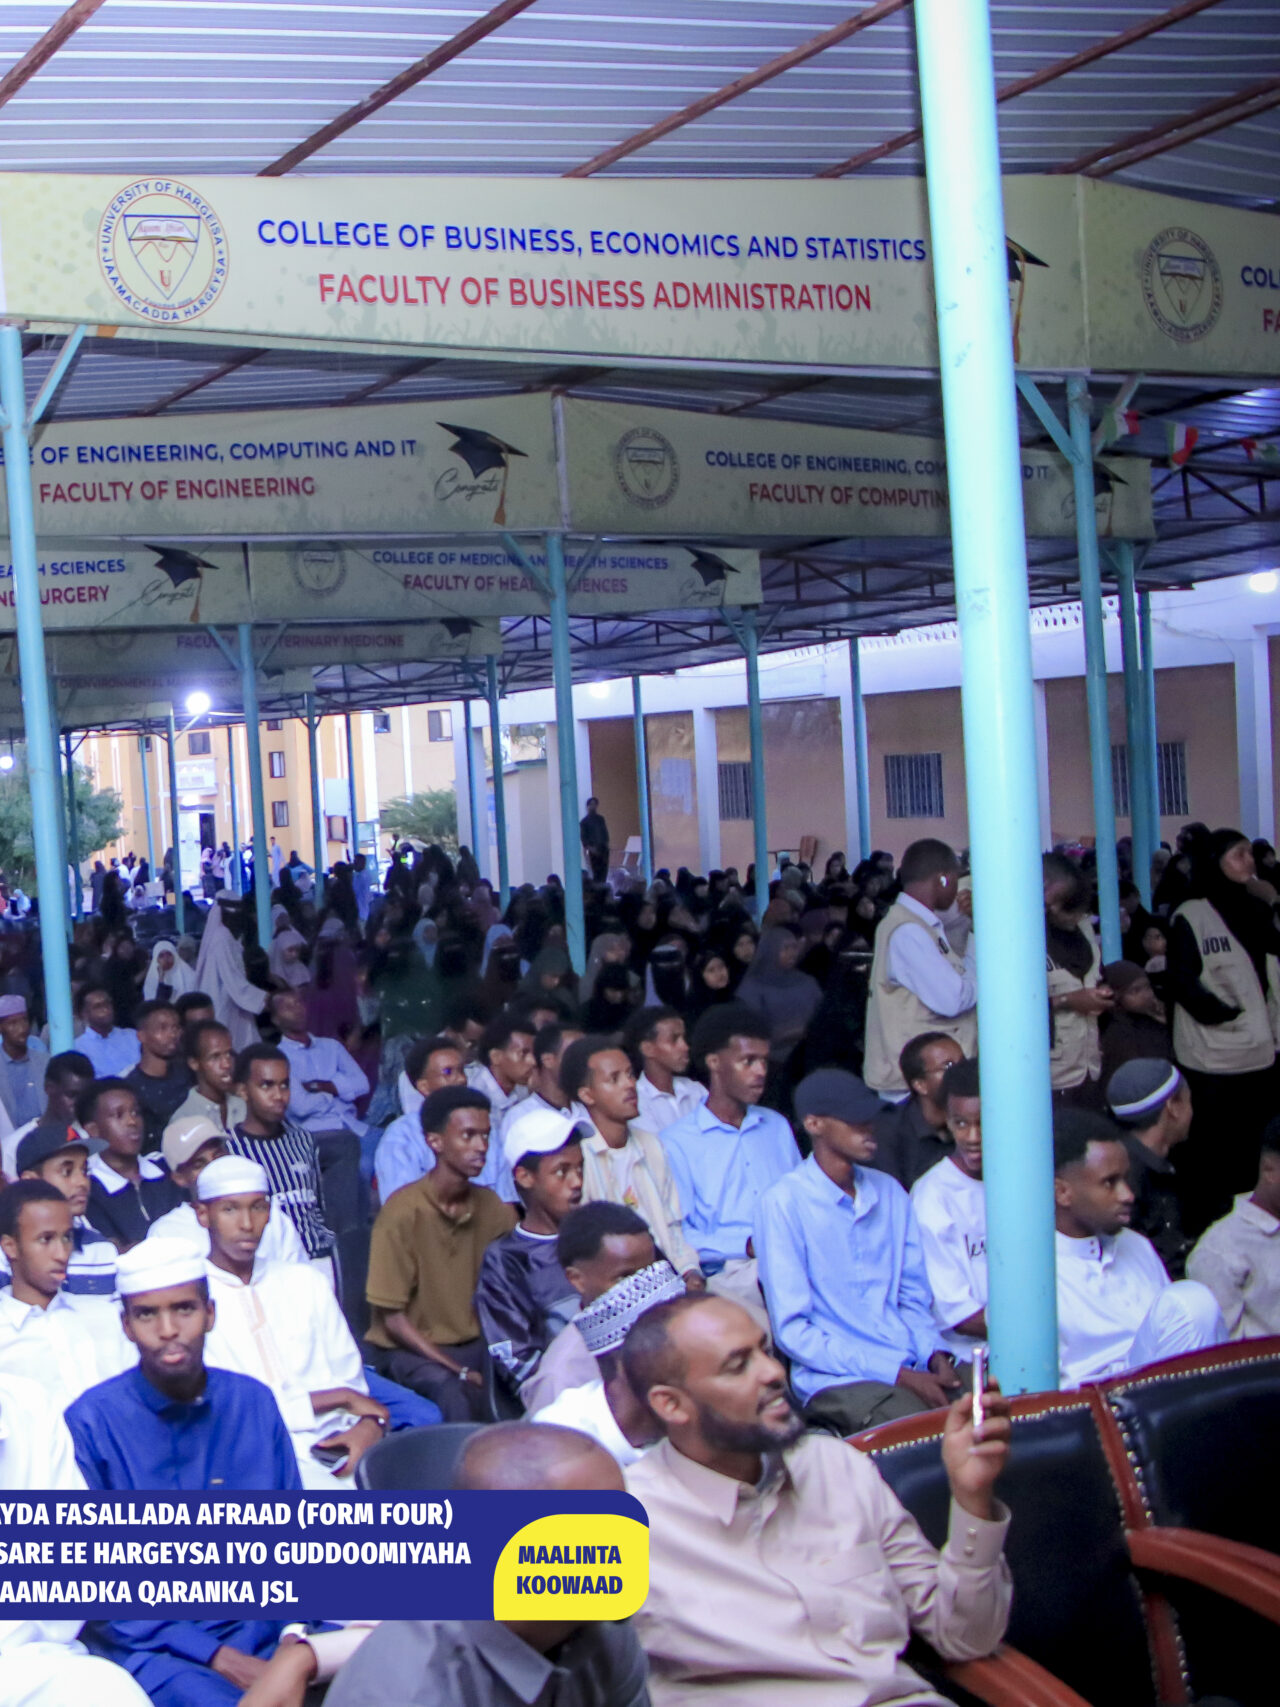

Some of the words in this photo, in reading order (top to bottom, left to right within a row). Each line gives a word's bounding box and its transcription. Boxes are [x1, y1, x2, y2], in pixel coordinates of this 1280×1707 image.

[101, 182, 150, 244] UNIVERSITY
[154, 181, 172, 192] OF
[175, 186, 223, 245] HARGEISA
[257, 219, 388, 248] COLLEGE
[398, 224, 435, 249] OF
[446, 227, 584, 256] BUSINESS,
[590, 231, 740, 257] ECONOMICS
[748, 235, 798, 258] AND
[805, 237, 926, 262] STATISTICS
[102, 256, 180, 321] JAAMACADDA
[184, 257, 226, 317] HARGEYSA
[318, 273, 452, 305] FACULTY
[460, 277, 500, 306] OF
[510, 279, 645, 310] BUSINESS
[653, 282, 872, 312] ADMINISTRATION
[41, 446, 69, 464] OF
[77, 443, 224, 464] ENGINEERING,
[229, 441, 349, 460] COMPUTING
[354, 440, 396, 457] AND
[401, 439, 418, 456] IT
[705, 450, 777, 469] COLLEGE
[781, 453, 803, 470] OF
[807, 454, 912, 475] ENGINEERING,
[1037, 465, 1049, 479] IT
[39, 481, 134, 503] FACULTY
[140, 479, 169, 500] OF
[176, 476, 317, 499] ENGINEERING
[749, 483, 825, 505] FACULTY
[831, 486, 854, 505] OF
[50, 558, 126, 575] SCIENCES
[372, 550, 435, 565] COLLEGE
[438, 551, 458, 564] OF
[610, 556, 669, 570] SCIENCES
[403, 574, 470, 591] FACULTY
[475, 575, 495, 591] OF
[343, 634, 404, 648] MEDICINE
